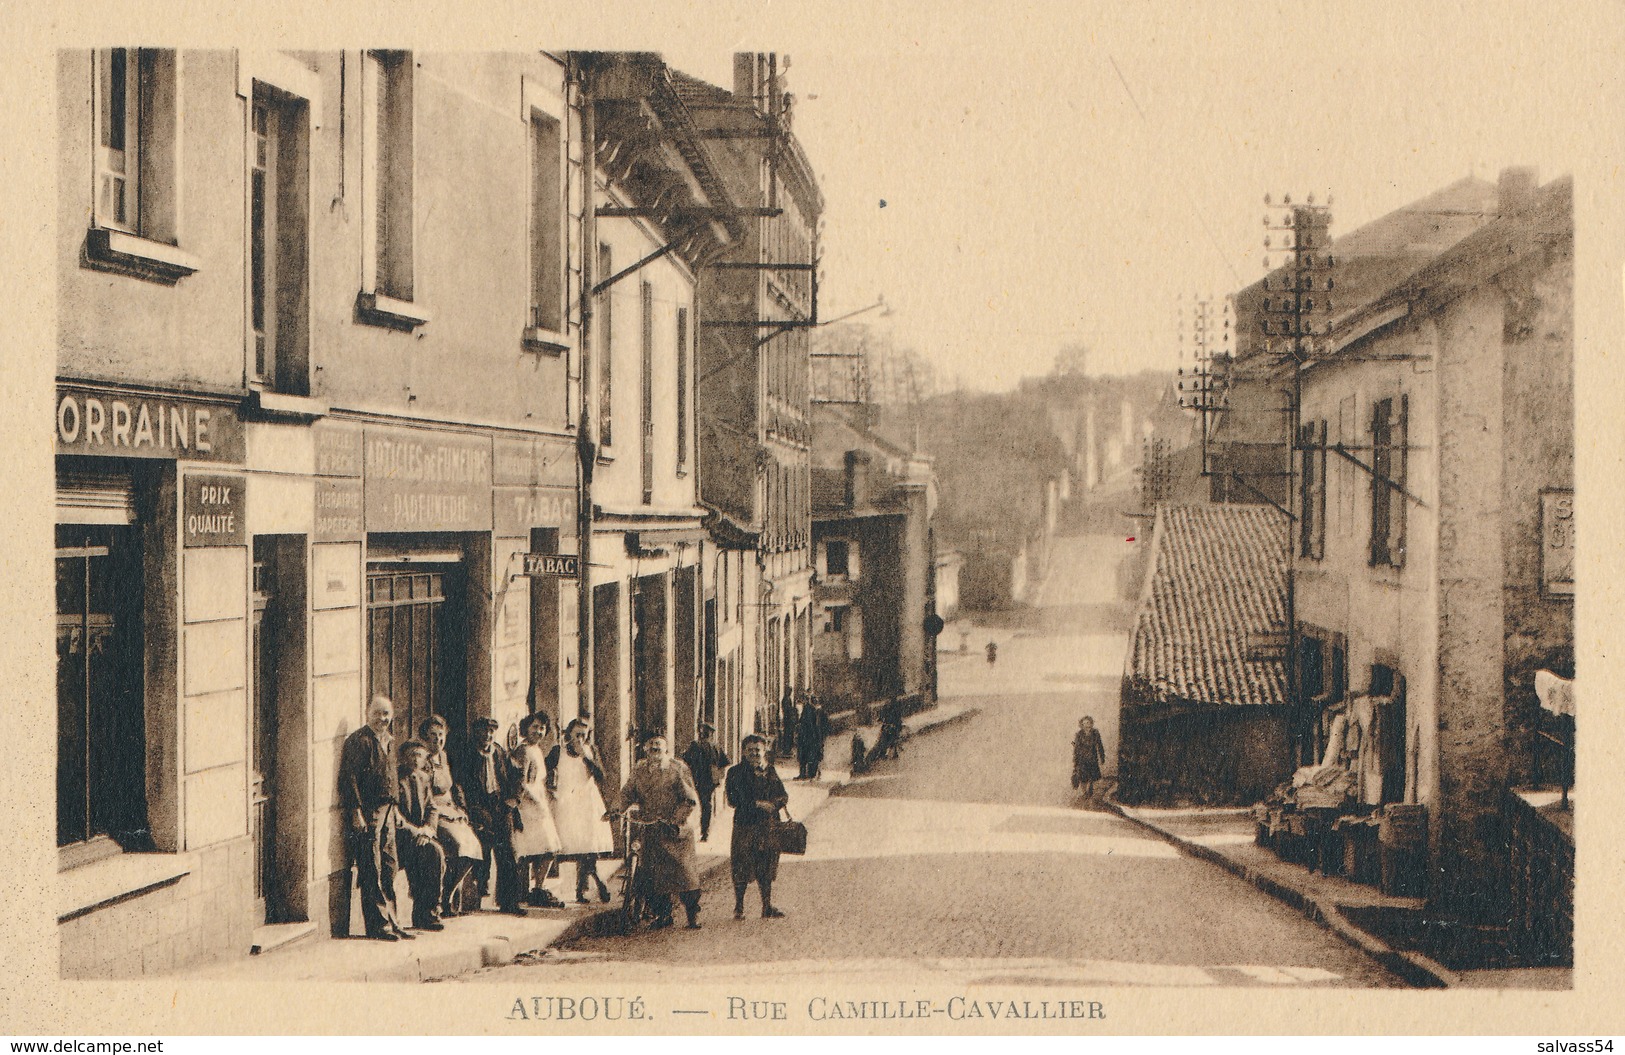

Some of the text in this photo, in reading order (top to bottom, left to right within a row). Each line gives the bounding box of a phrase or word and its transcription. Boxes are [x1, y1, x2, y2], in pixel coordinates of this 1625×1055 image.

[367, 440, 423, 479] ARTICLES
[437, 446, 489, 484] FUMEURS
[201, 485, 231, 505] PRIX
[393, 493, 470, 524] PARFUMERIE
[514, 497, 573, 523] TABAC
[189, 511, 236, 537] QUALITÉ
[526, 558, 574, 573] TABAC
